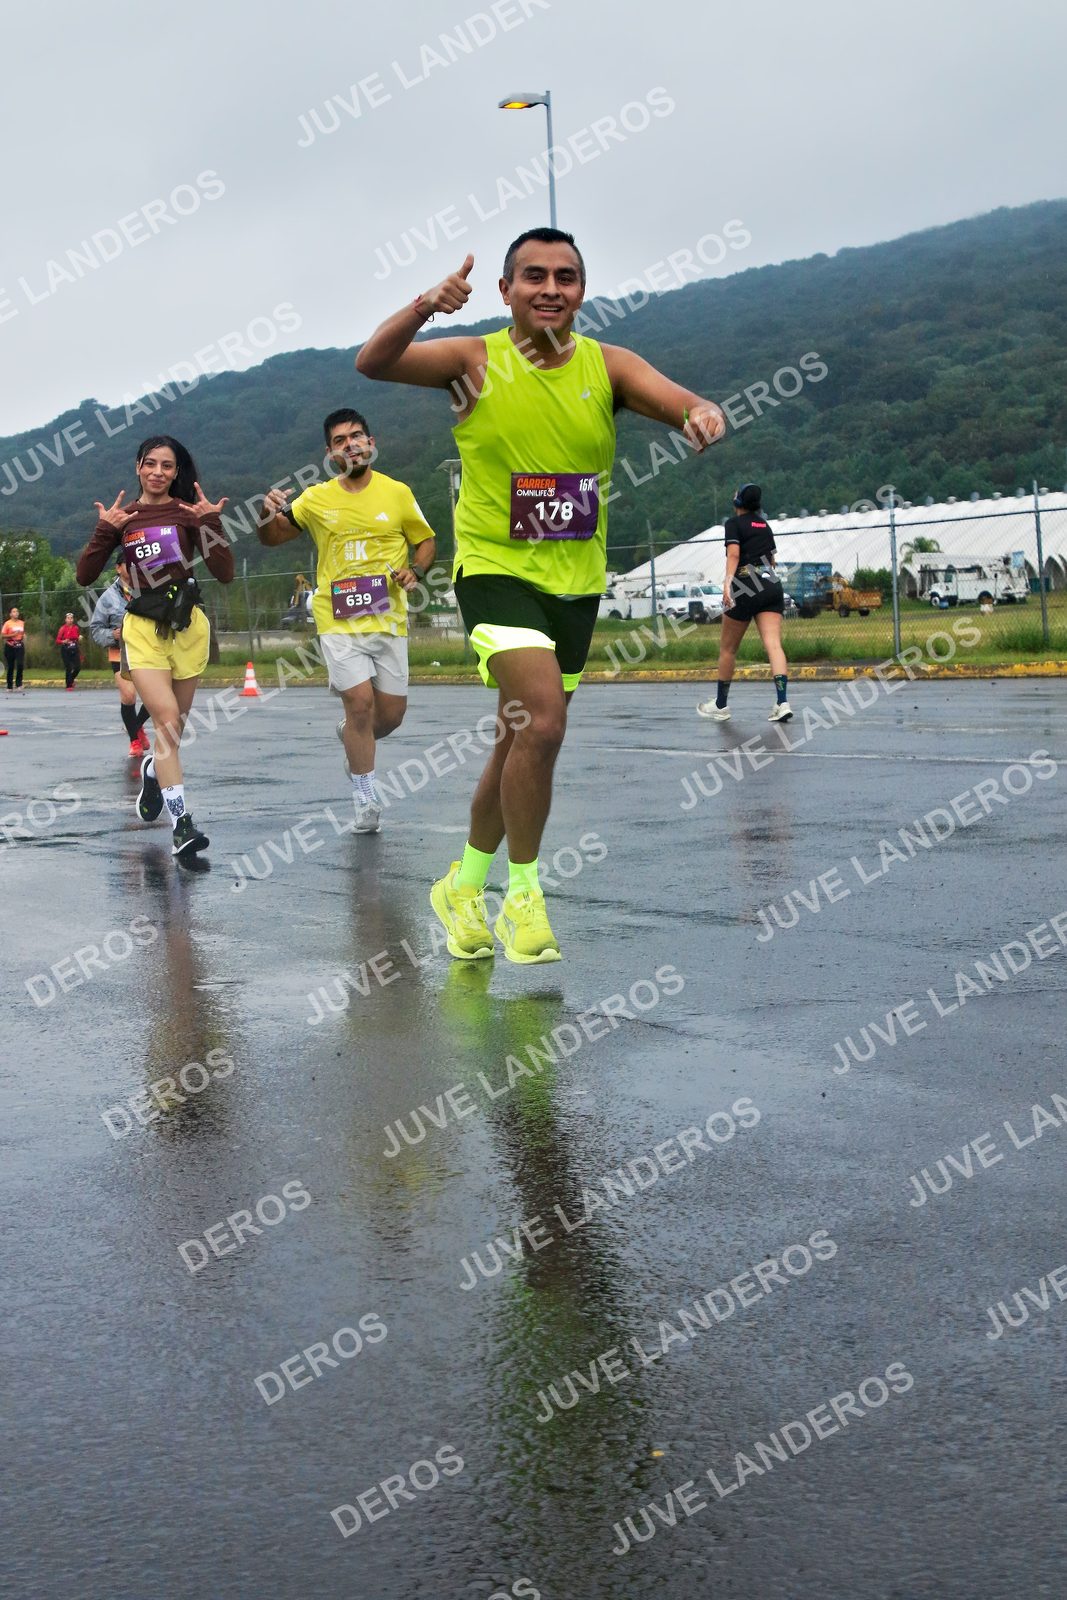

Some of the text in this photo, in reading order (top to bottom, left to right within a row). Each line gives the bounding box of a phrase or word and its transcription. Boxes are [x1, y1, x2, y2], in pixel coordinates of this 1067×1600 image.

[516, 478, 556, 489] CARRERA
[535, 501, 573, 520] 178
[135, 542, 161, 559] 638
[355, 540, 368, 561] K
[346, 593, 372, 607] 639
